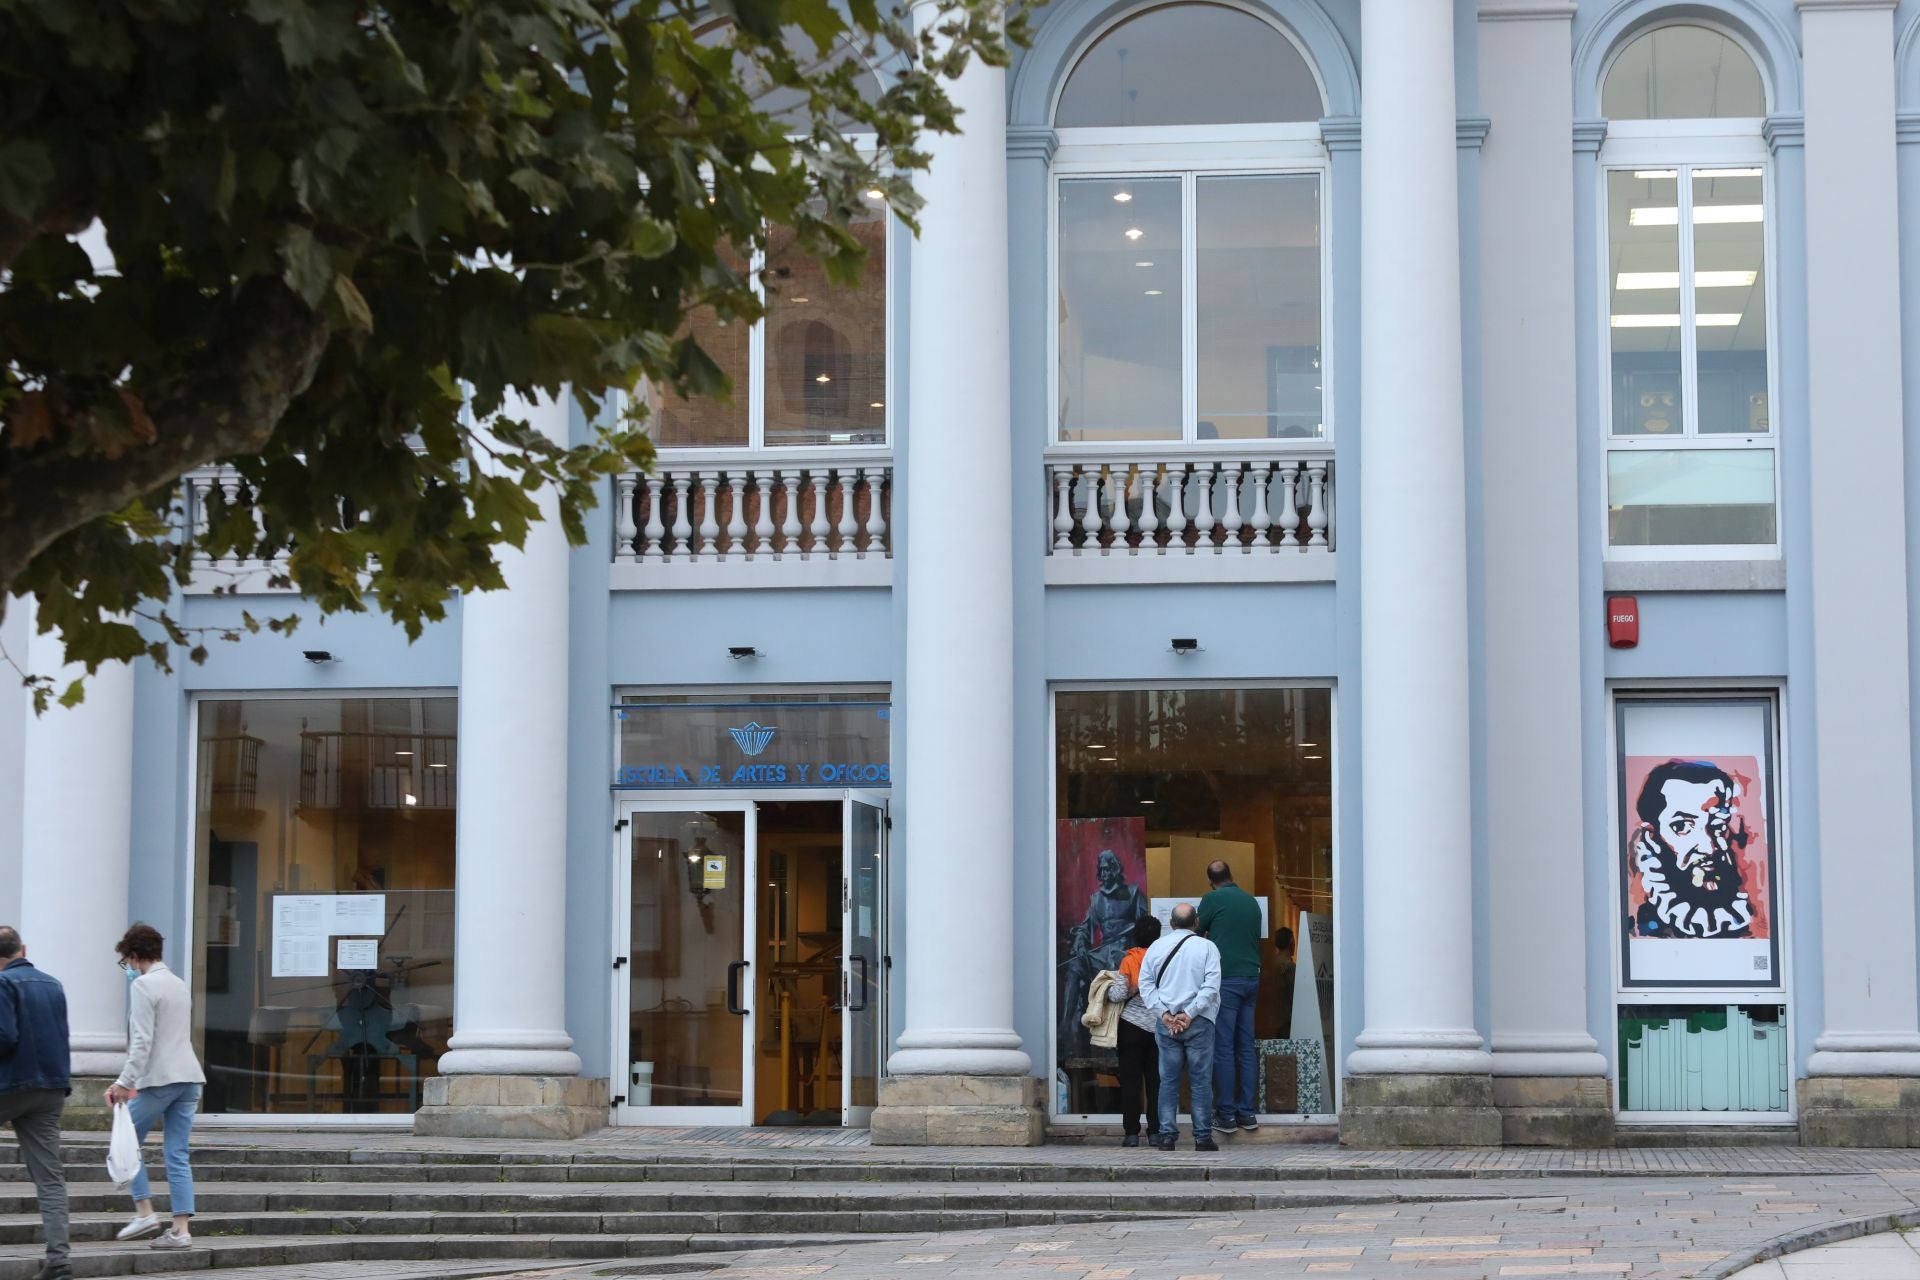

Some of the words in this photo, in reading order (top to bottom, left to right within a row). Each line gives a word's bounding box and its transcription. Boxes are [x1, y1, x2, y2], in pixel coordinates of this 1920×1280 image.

[1612, 615, 1634, 623] FUEGO
[701, 765, 720, 782] DE
[731, 764, 786, 782] ARTES
[796, 764, 810, 782] Y
